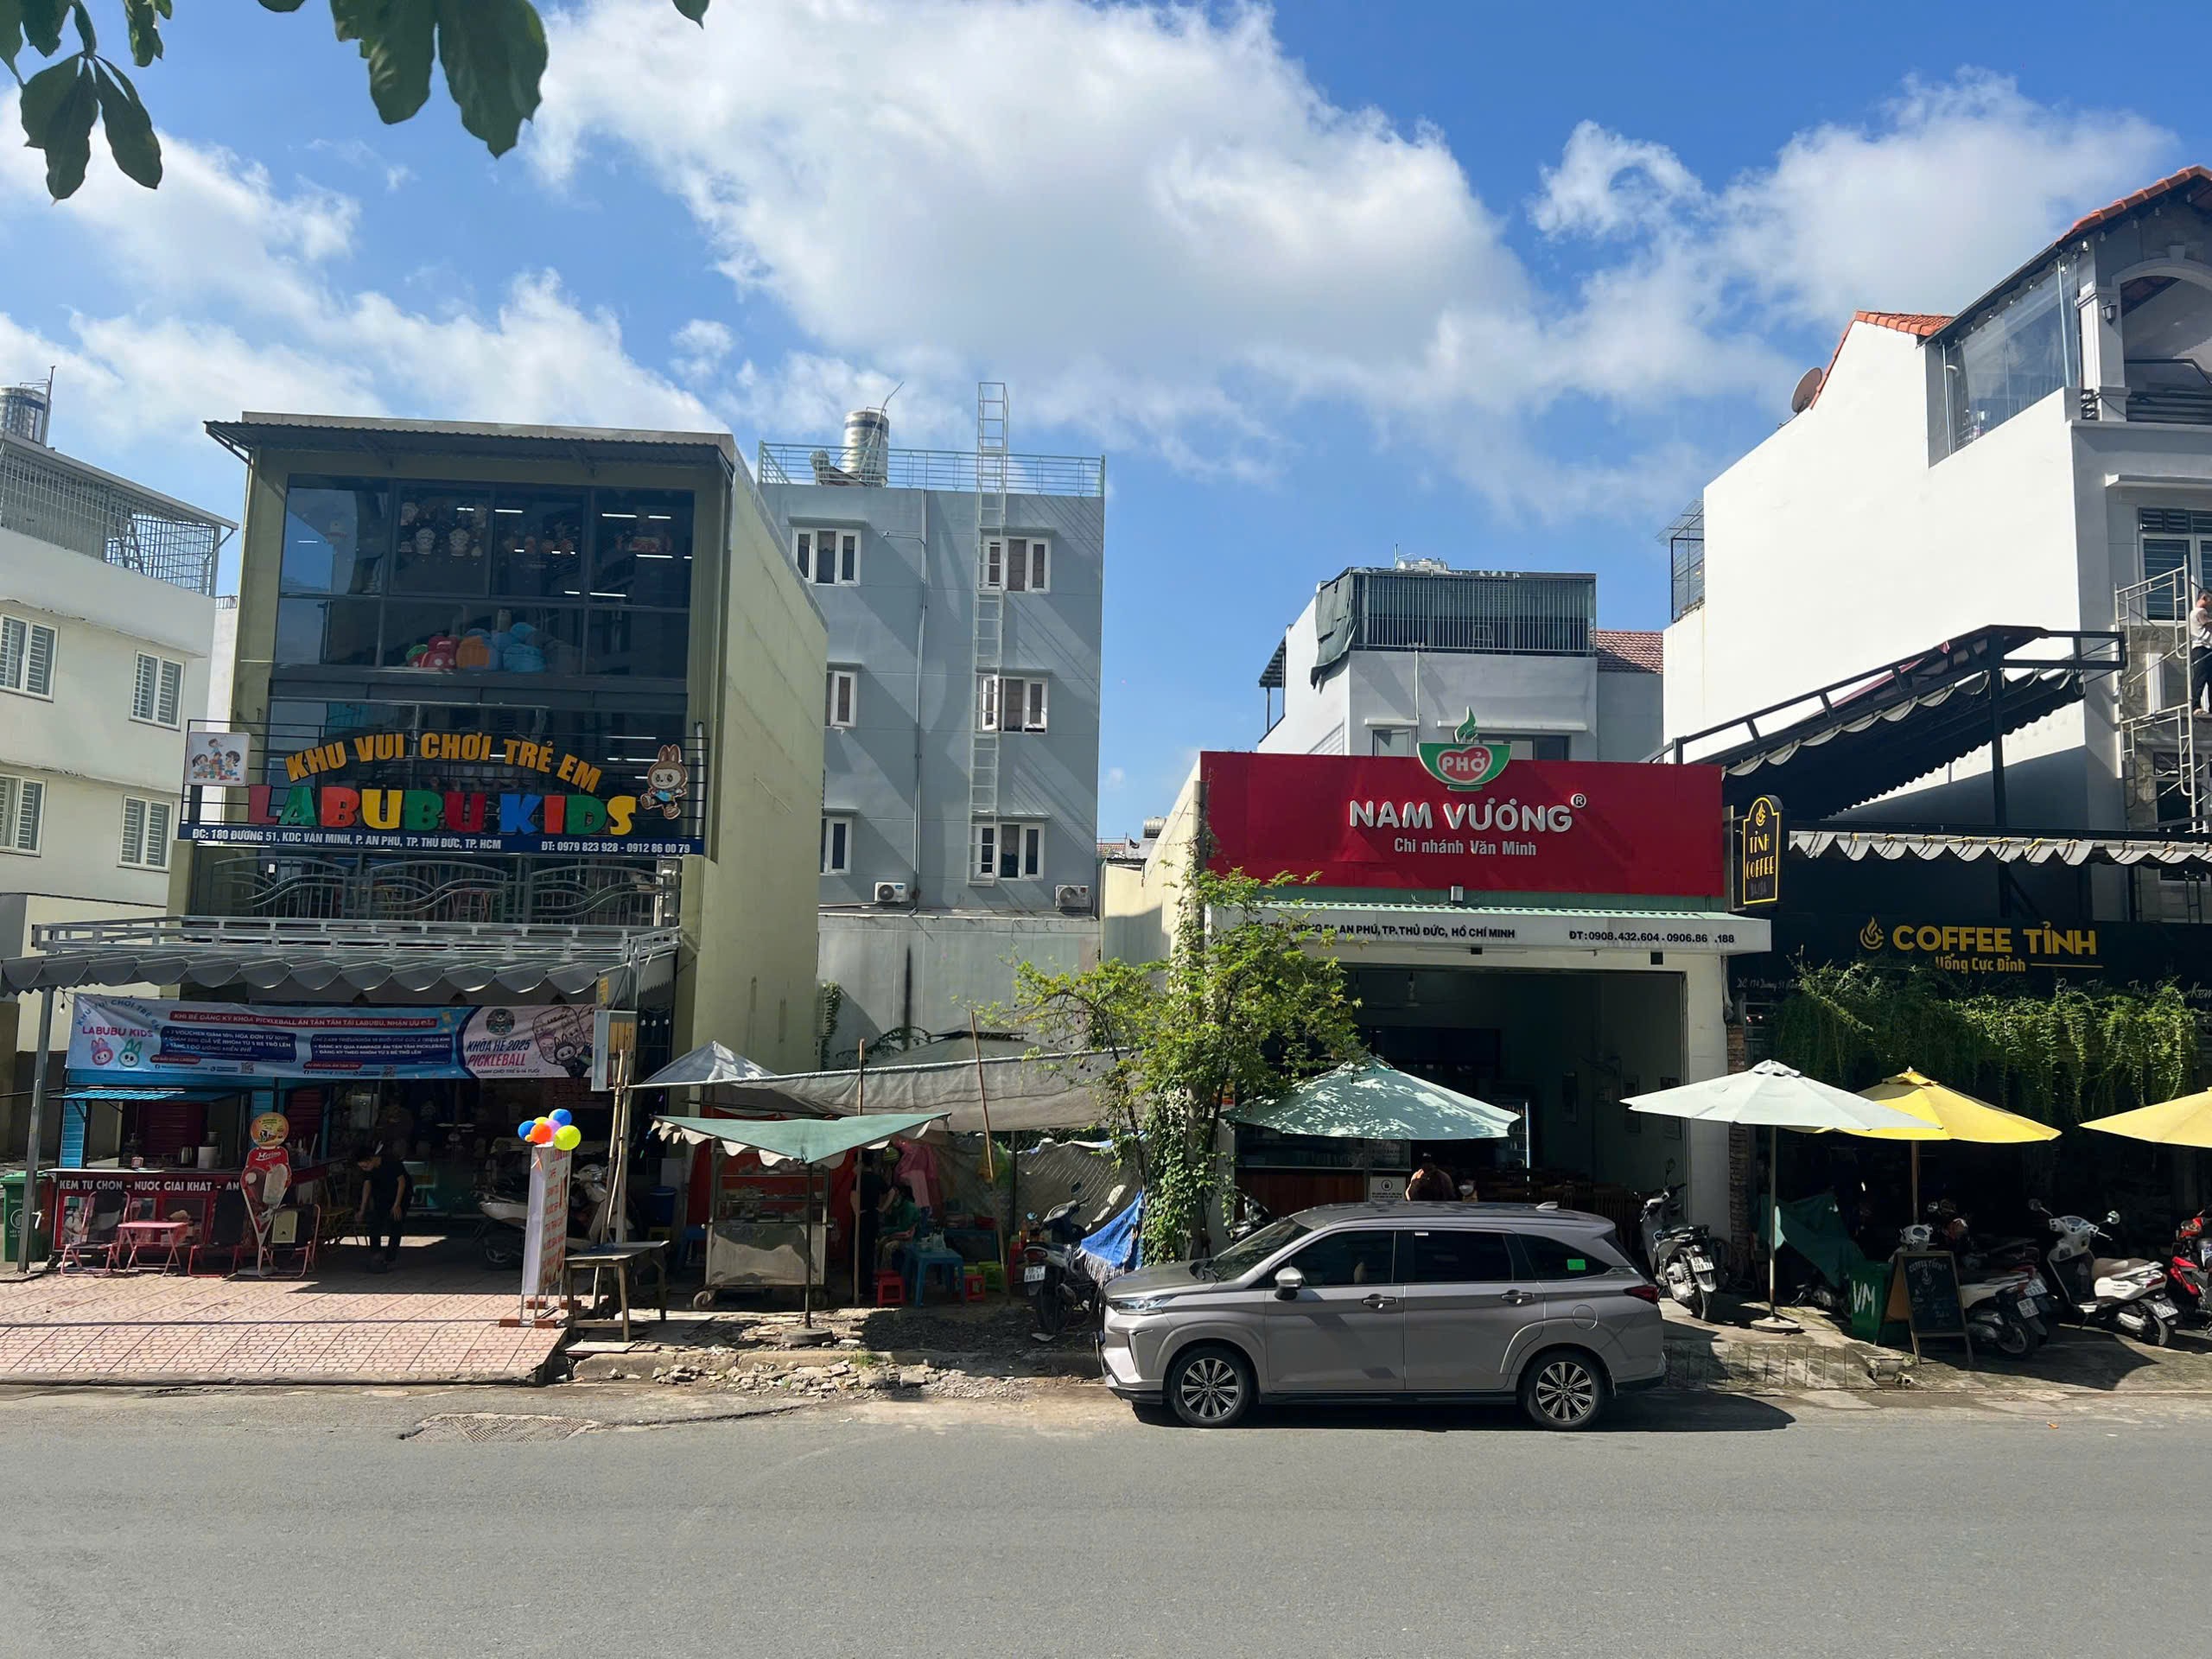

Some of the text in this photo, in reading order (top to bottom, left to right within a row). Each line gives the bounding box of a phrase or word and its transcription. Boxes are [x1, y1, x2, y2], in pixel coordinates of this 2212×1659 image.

[284, 732, 601, 793] KHU VUI CHƠI TRẺ EM
[1441, 751, 1486, 772] PHỞ
[248, 785, 637, 836] LABUBU KIDS
[1349, 800, 1433, 830] NAM
[1443, 798, 1573, 833] VƯƠNG
[192, 829, 209, 840] ĐC:
[211, 830, 229, 840] 180
[265, 831, 280, 843] 51,
[283, 832, 302, 843] KDC
[325, 833, 353, 845] MINH,
[355, 835, 364, 845] P.
[365, 835, 379, 846] AN
[406, 836, 419, 848] TP.
[465, 840, 478, 849] TP.
[480, 840, 501, 849] HCM
[541, 841, 556, 852] ĐT:
[556, 842, 580, 852] 0979
[582, 842, 599, 853] 823
[601, 842, 618, 853] 928
[626, 843, 649, 854] 0912
[651, 843, 663, 854] 86
[664, 843, 677, 854] 00
[678, 843, 690, 854] 79
[1394, 837, 1537, 856] Chi nhánh Văn Minh
[1746, 855, 1775, 880] COFFEE
[1339, 925, 1355, 934] AN
[1356, 923, 1381, 936] PHÚ,
[1422, 925, 1448, 938] ĐỨC,
[1469, 925, 1487, 938] CHÍ
[1489, 929, 1516, 938] MINH
[1892, 921, 2097, 955] COFFEE TỈNH
[1972, 957, 1994, 975] Cực
[1997, 955, 2026, 972] Đỉnh
[256, 1017, 296, 1026] PICKLEBALL
[82, 1026, 154, 1038] LABUBU KIDS
[505, 1039, 531, 1052] 2025
[467, 1053, 526, 1066] PICKLEBALL
[60, 1179, 79, 1190] KEM
[1853, 1280, 1876, 1319] VM
